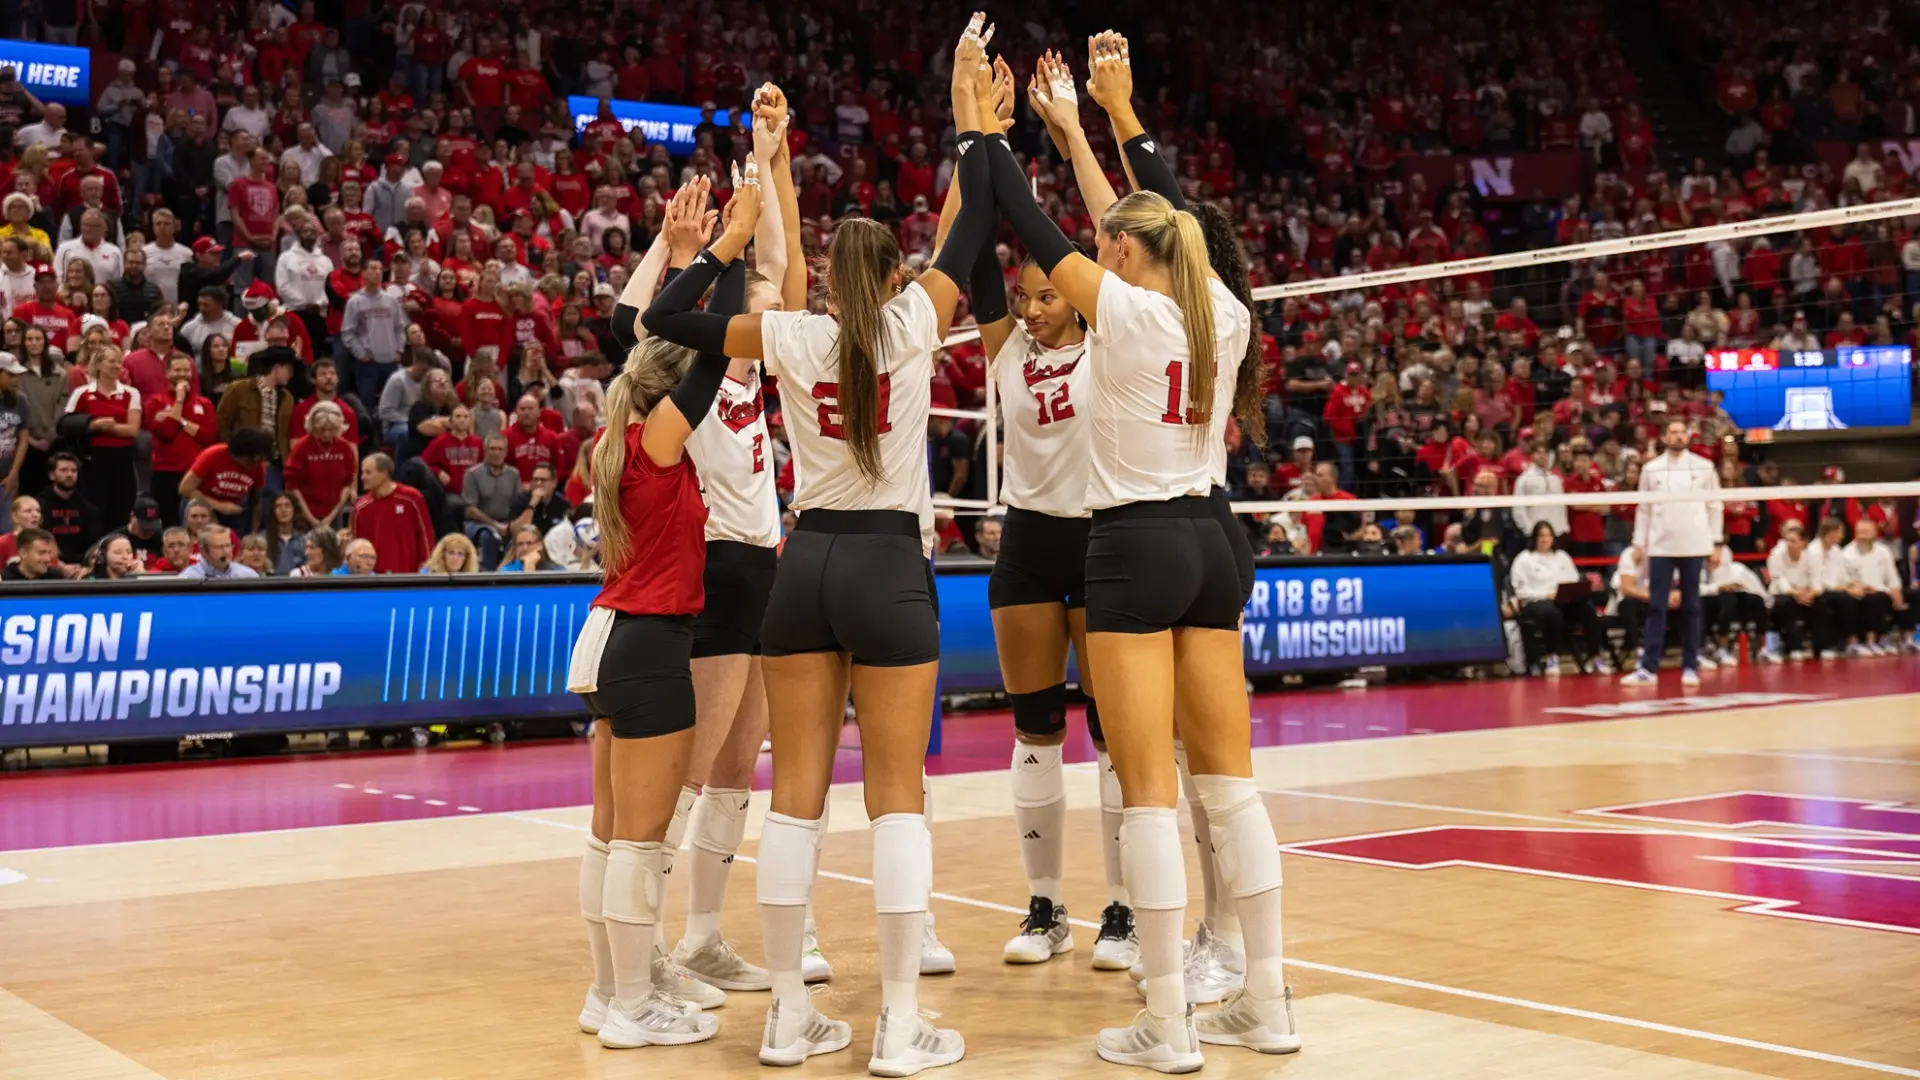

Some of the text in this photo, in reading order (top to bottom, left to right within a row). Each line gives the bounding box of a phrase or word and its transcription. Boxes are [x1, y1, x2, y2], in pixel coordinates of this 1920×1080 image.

[27, 62, 80, 88] HERE
[1470, 158, 1515, 196] N
[1037, 381, 1076, 426] 12
[752, 433, 765, 475] 2
[1275, 579, 1304, 617] 18
[1311, 578, 1331, 616] &
[1336, 577, 1363, 615] 21
[0, 611, 153, 665] SION I
[1277, 616, 1406, 660] MISSOURI
[0, 661, 342, 726] HAMPIONSHIP
